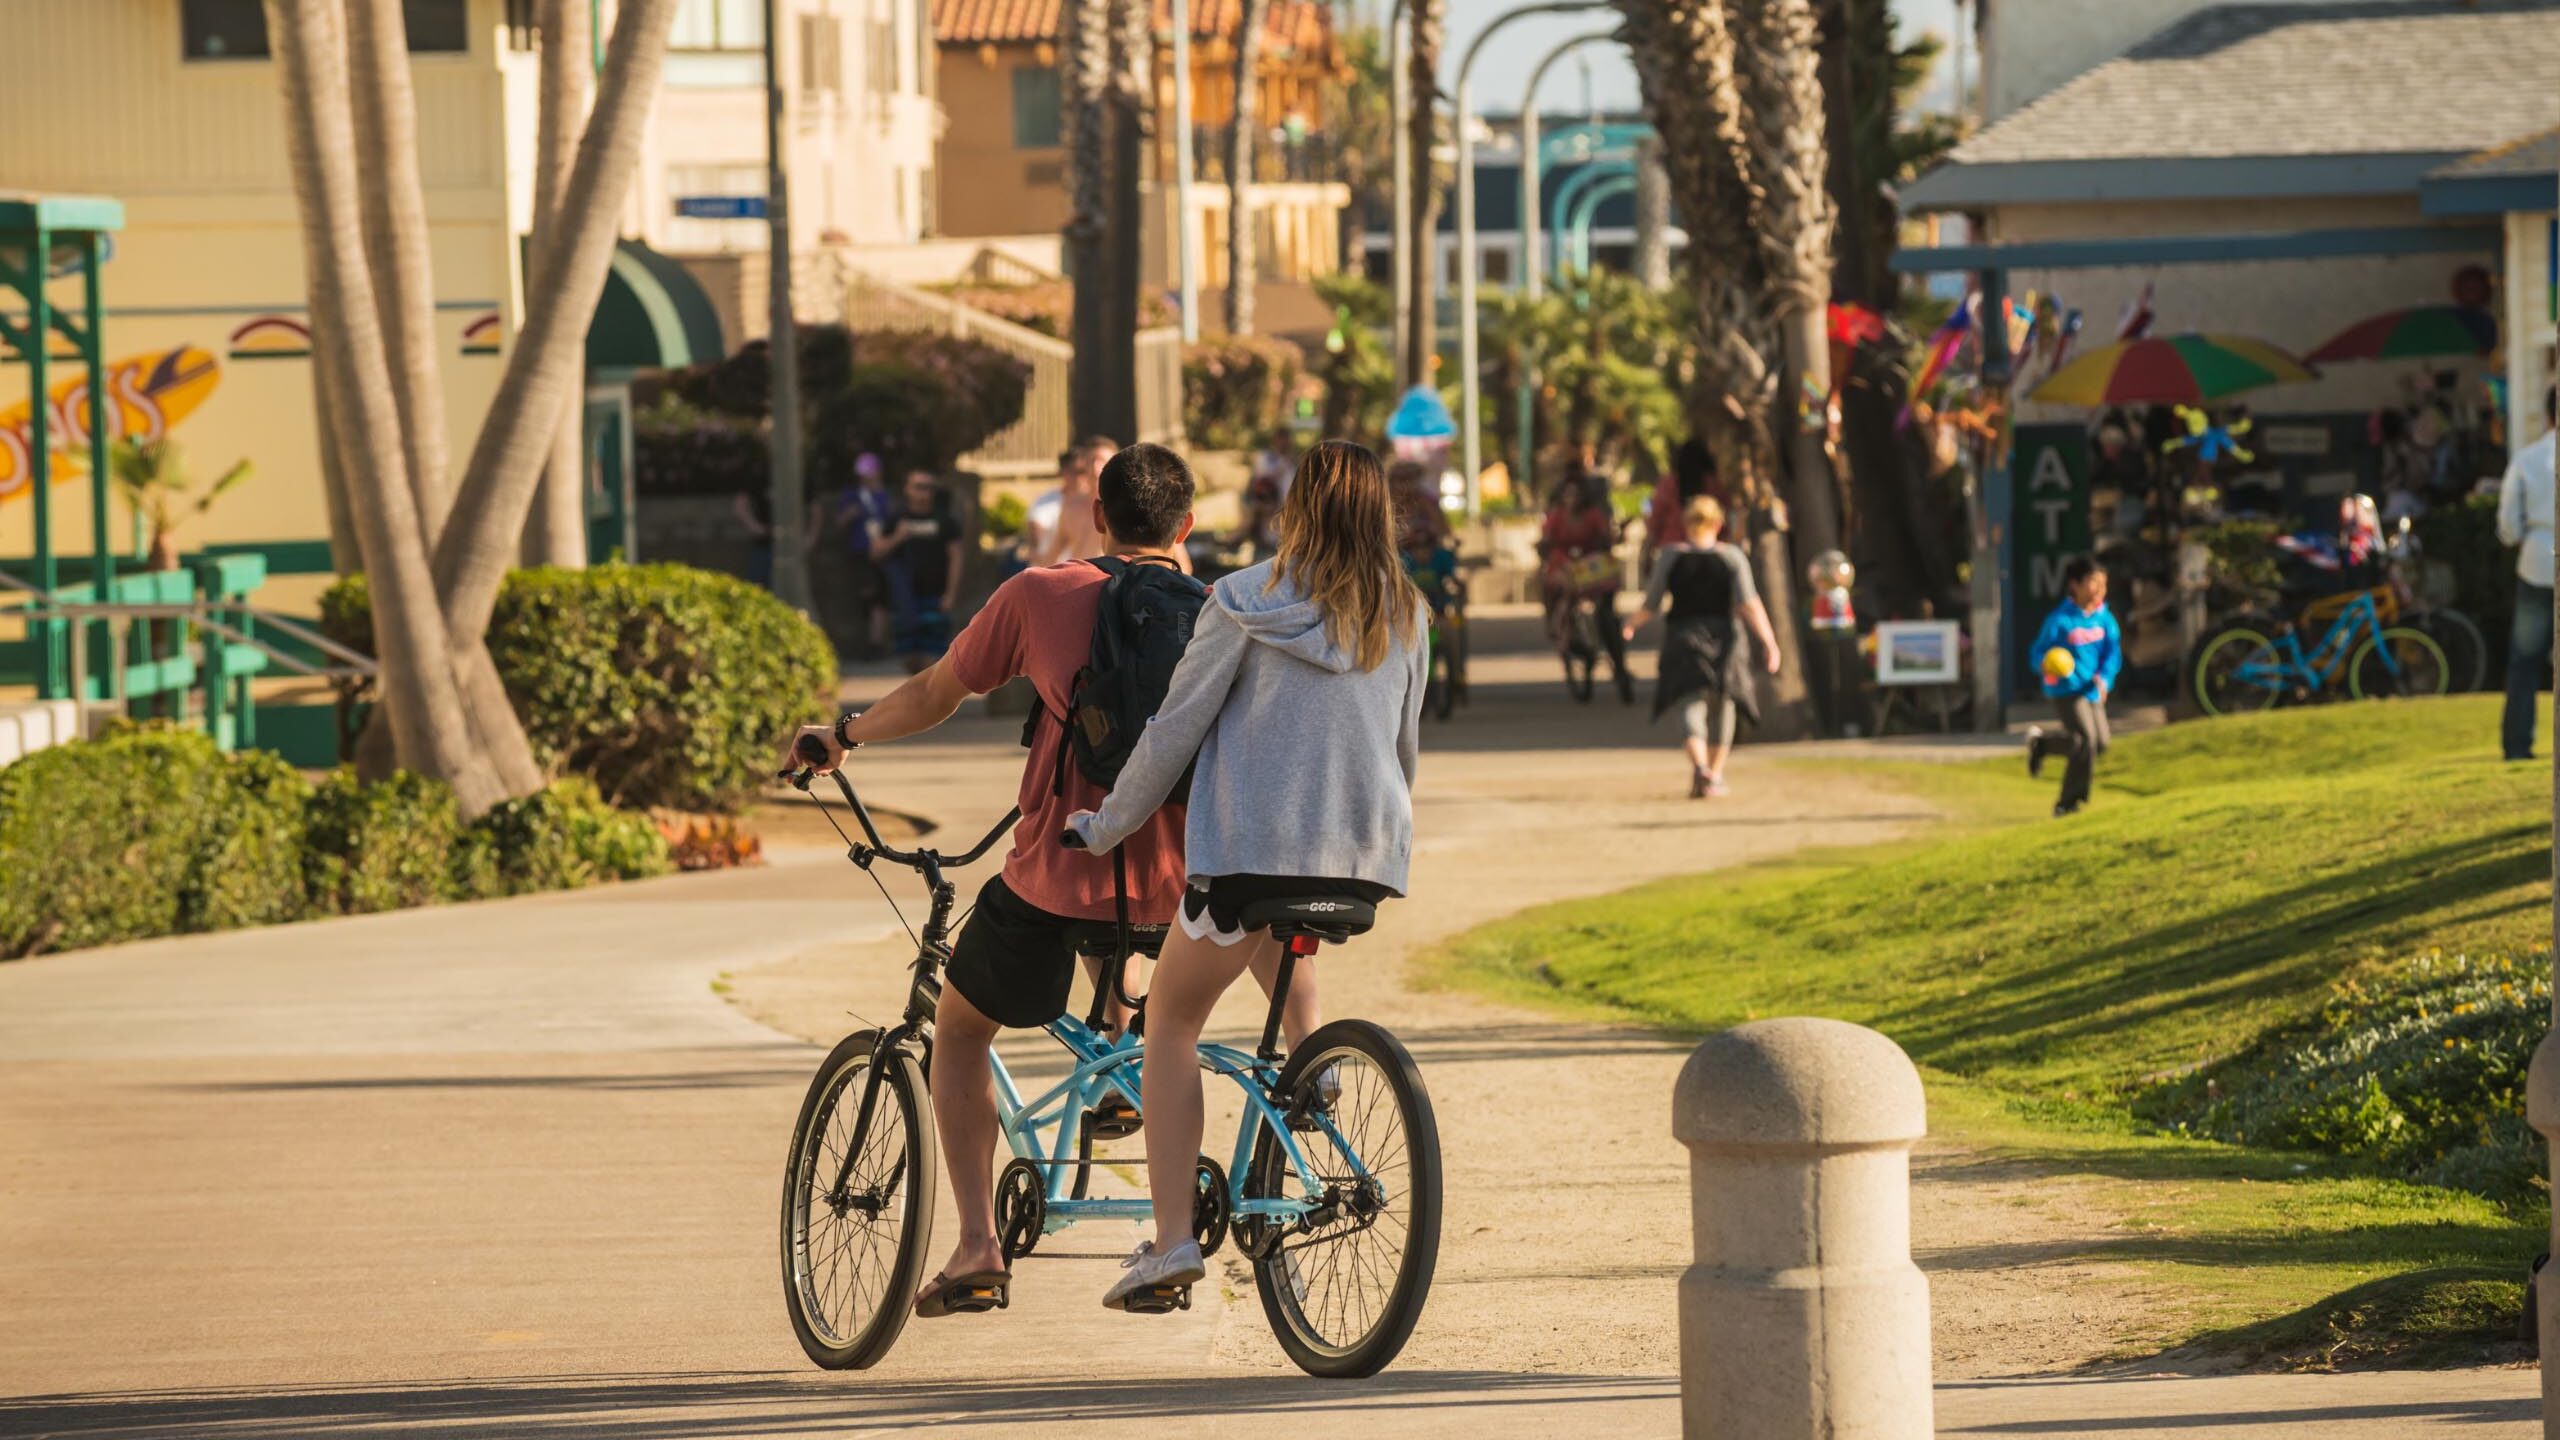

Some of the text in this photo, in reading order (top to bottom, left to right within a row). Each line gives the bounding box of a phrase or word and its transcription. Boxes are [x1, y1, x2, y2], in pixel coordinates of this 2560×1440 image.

[2029, 445, 2075, 598] ATM
[1310, 902, 1335, 911] GGG
[1133, 924, 1157, 932] GGG
